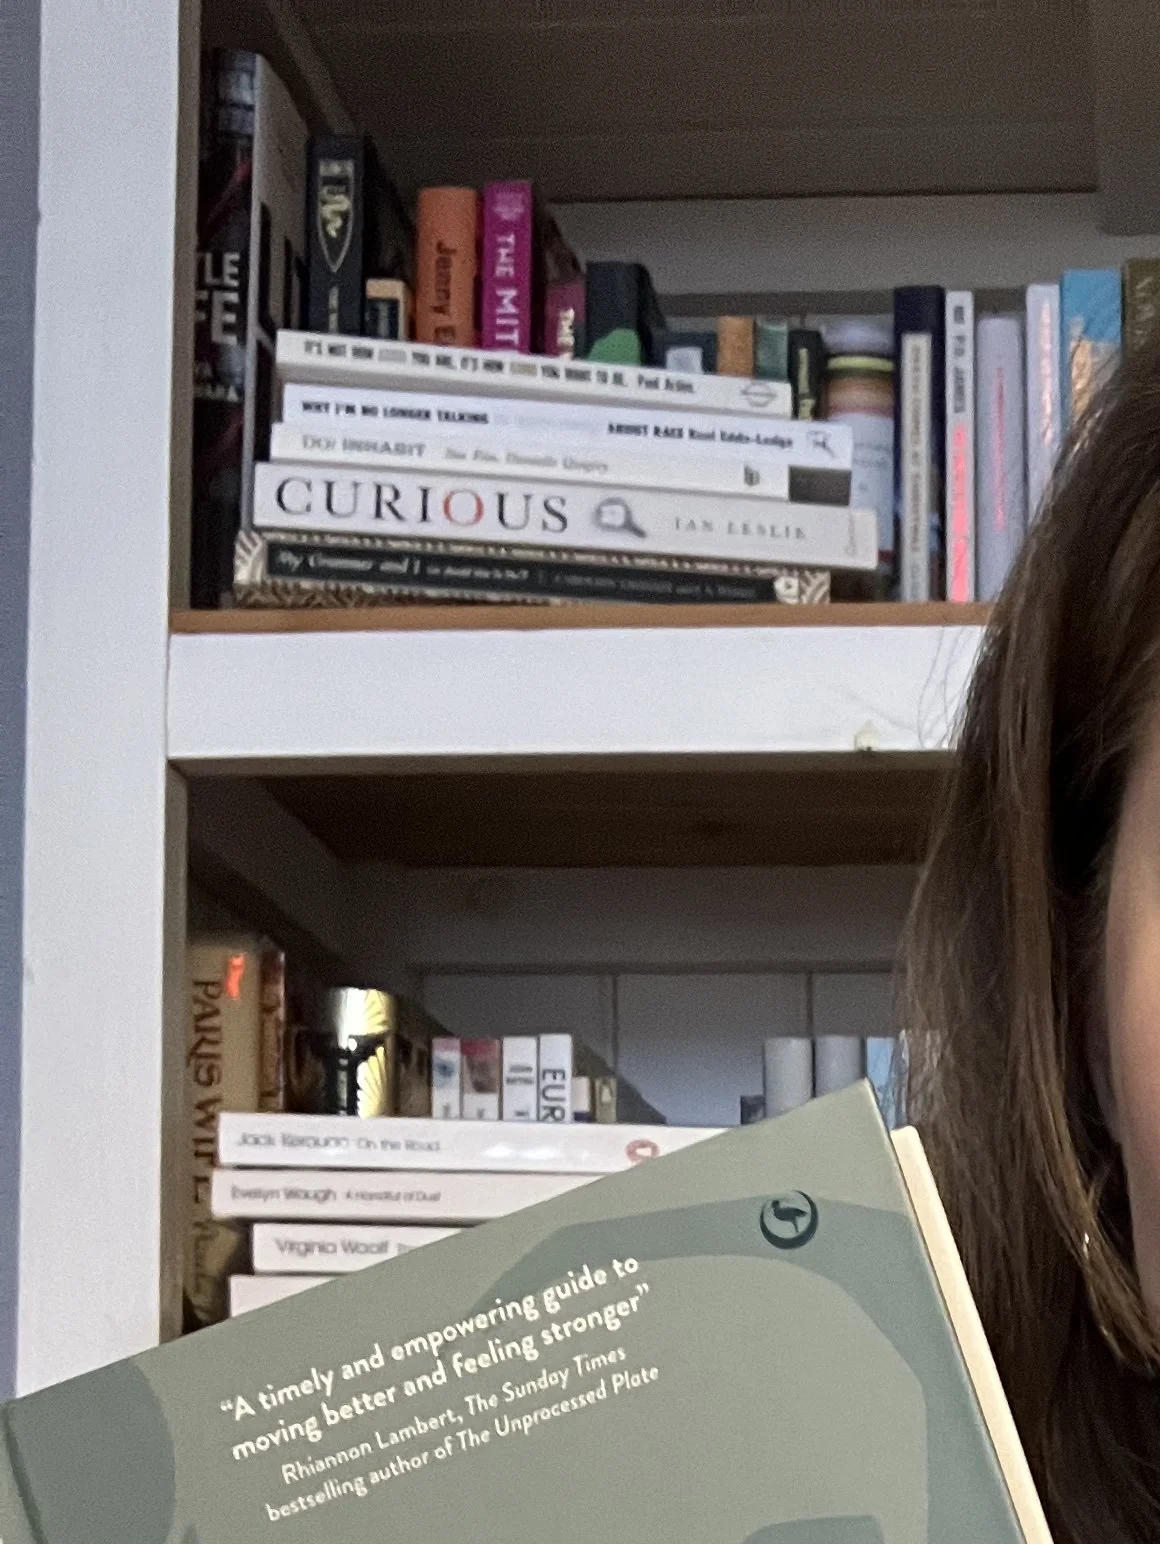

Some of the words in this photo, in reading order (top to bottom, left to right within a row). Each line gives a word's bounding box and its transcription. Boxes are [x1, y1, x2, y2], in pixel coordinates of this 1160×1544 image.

[197, 252, 240, 287] LE
[495, 232, 516, 278] THE
[275, 477, 569, 534] CURIOUS
[675, 516, 714, 533] IAN
[186, 980, 222, 1088] PARIS
[220, 1395, 256, 1421] “A
[258, 1368, 334, 1411] timely
[342, 1343, 385, 1380] and
[391, 1295, 540, 1363] empowering
[543, 1264, 607, 1314] guide
[613, 1258, 639, 1279] to
[232, 1416, 322, 1461] moving
[321, 1386, 396, 1426] better
[404, 1360, 447, 1397] and
[452, 1335, 539, 1378] feeling
[541, 1280, 649, 1345] stronger”
[265, 1477, 368, 1521] bestselling
[370, 1452, 428, 1484] author
[434, 1437, 455, 1460] of
[456, 1428, 490, 1451] The
[494, 1384, 607, 1436] Unprocessed
[612, 1367, 658, 1395] Plate
[282, 1443, 372, 1484] Rhiannon
[376, 1409, 463, 1450] Lambert,
[464, 1393, 498, 1416] The
[502, 1368, 569, 1402] Sunday
[573, 1348, 626, 1376] Times
